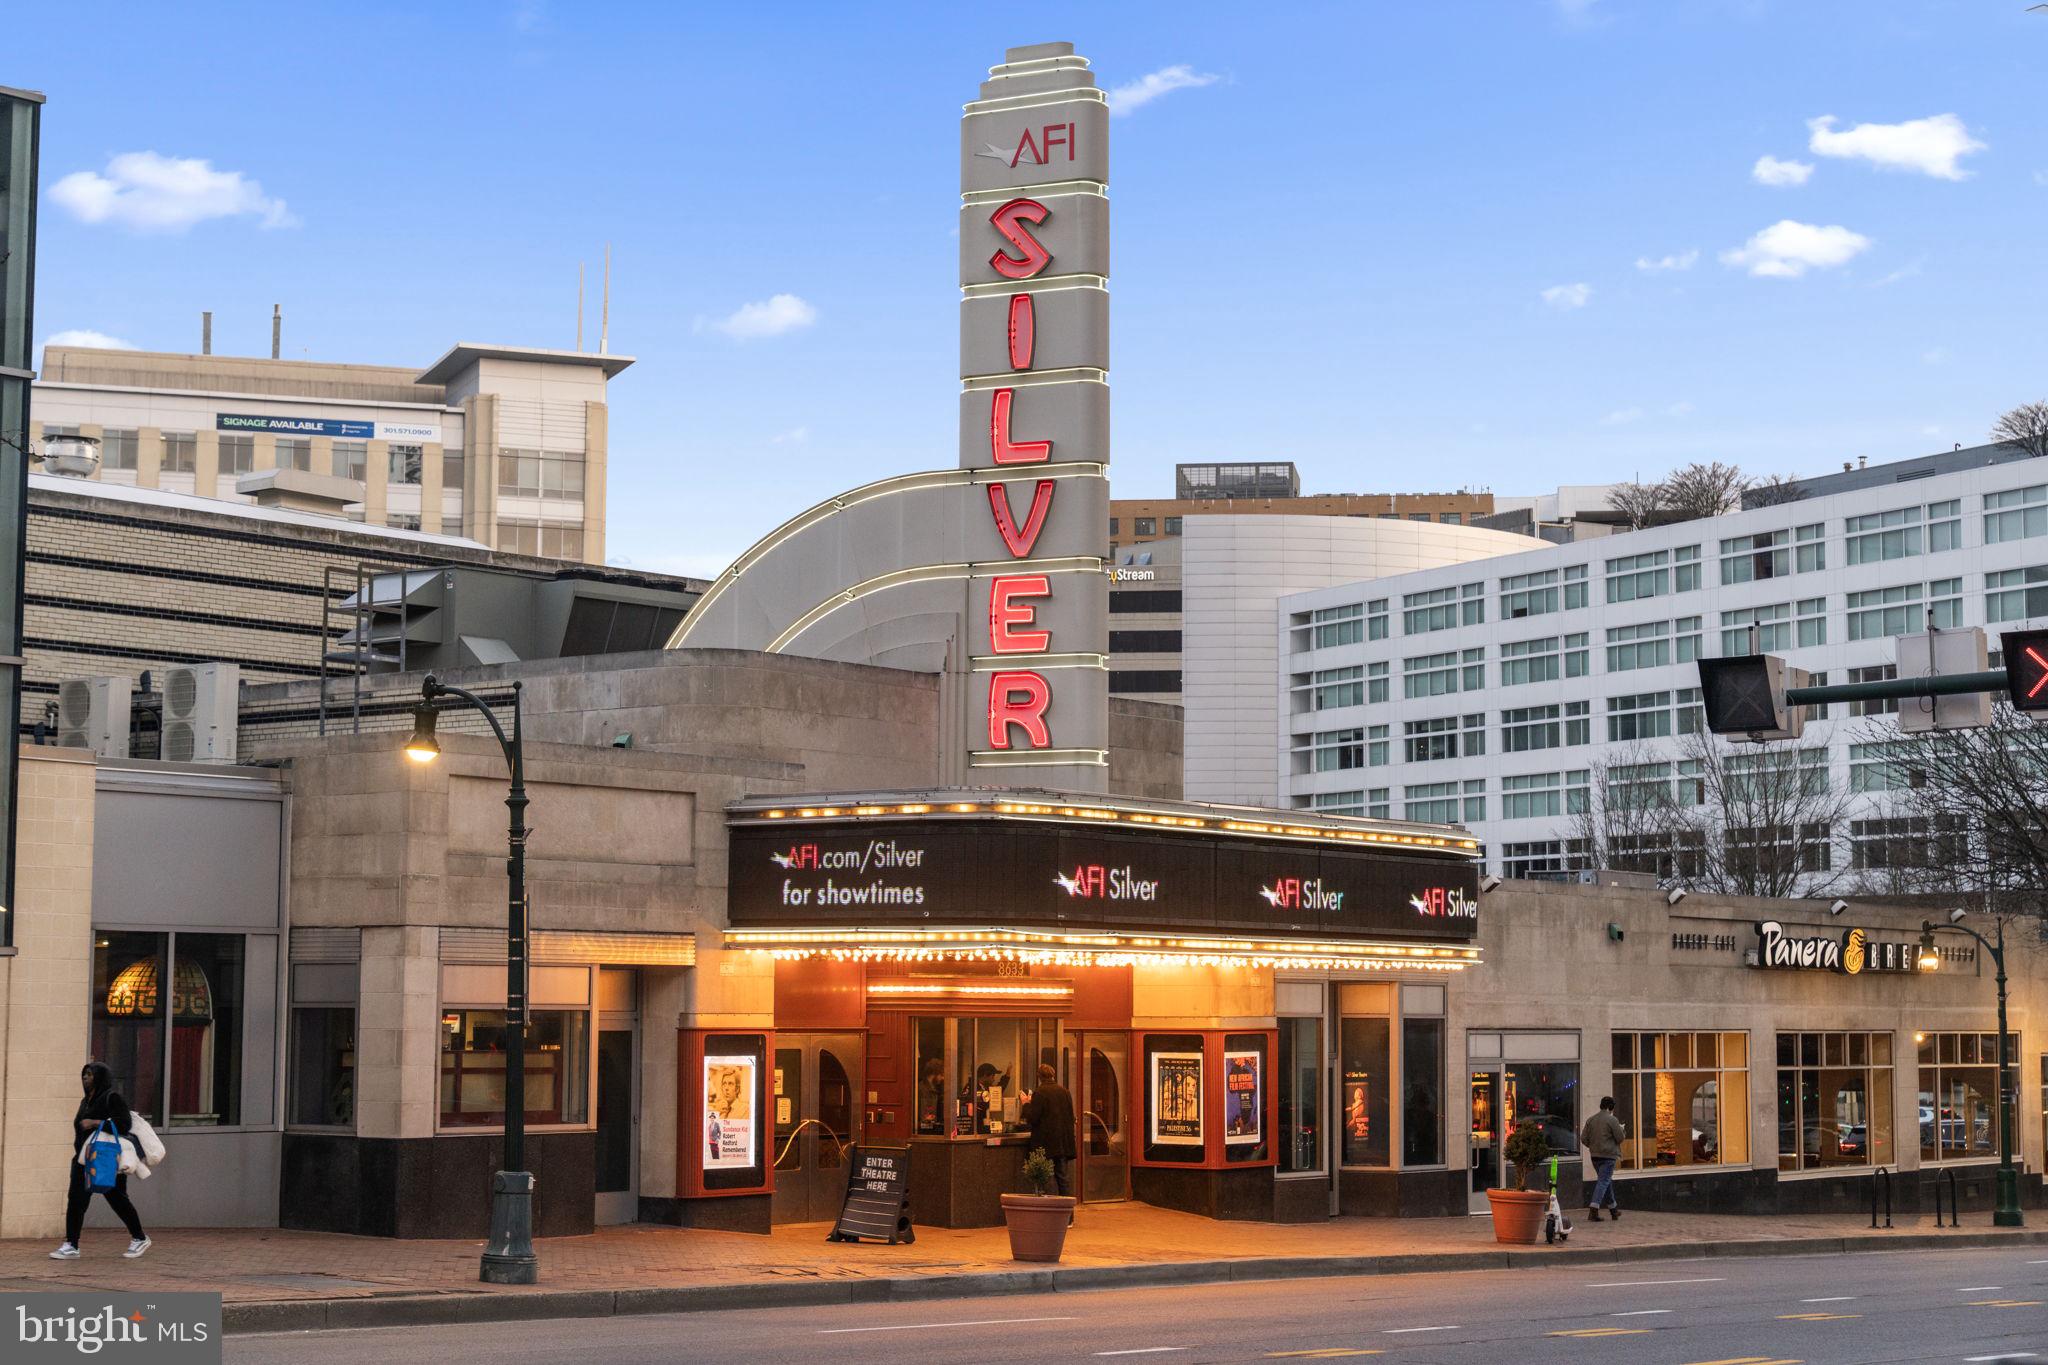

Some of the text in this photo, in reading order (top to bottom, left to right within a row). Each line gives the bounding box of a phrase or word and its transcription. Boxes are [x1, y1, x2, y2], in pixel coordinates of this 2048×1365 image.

[1010, 123, 1075, 168] AFI
[223, 417, 323, 430] SIGNAGE AVAILABLE
[987, 197, 1056, 749] SILVER
[788, 840, 924, 873] AFI.com/Silver
[783, 879, 924, 904] for showtimes
[1073, 865, 1158, 900] AFI Silver
[1273, 879, 1344, 910] AFI Silver
[1421, 888, 1445, 915] AFI
[1762, 921, 1839, 967] Panera
[861, 1167, 897, 1180] THEATRE
[866, 1157, 893, 1168] ENTER
[866, 1181, 888, 1191] HERE
